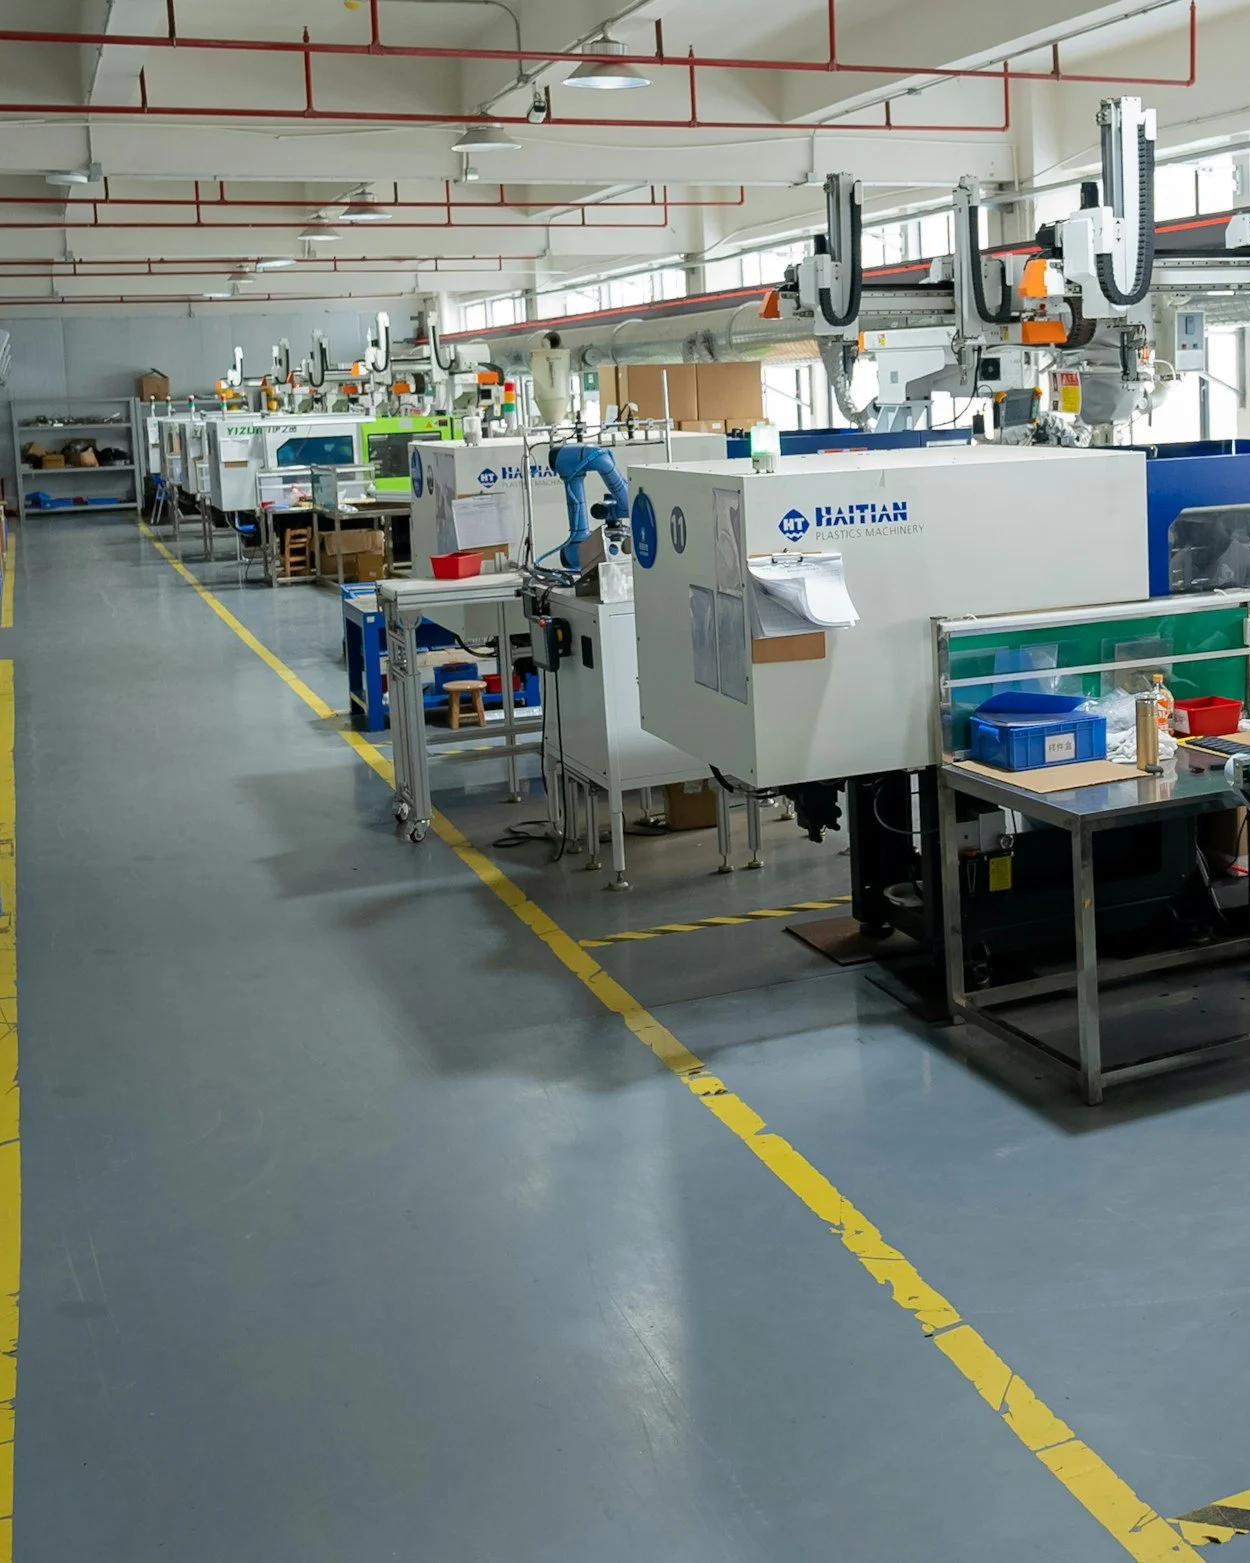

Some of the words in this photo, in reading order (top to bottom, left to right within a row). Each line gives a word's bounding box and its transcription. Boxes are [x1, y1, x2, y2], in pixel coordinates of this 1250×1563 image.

[480, 473, 494, 482] HT
[502, 465, 558, 479] HATIA
[815, 501, 908, 527] HAITIAN
[671, 514, 685, 546] 11
[783, 517, 805, 532] HT
[816, 527, 862, 541] PLASTICS
[865, 523, 924, 538] MACHINERY
